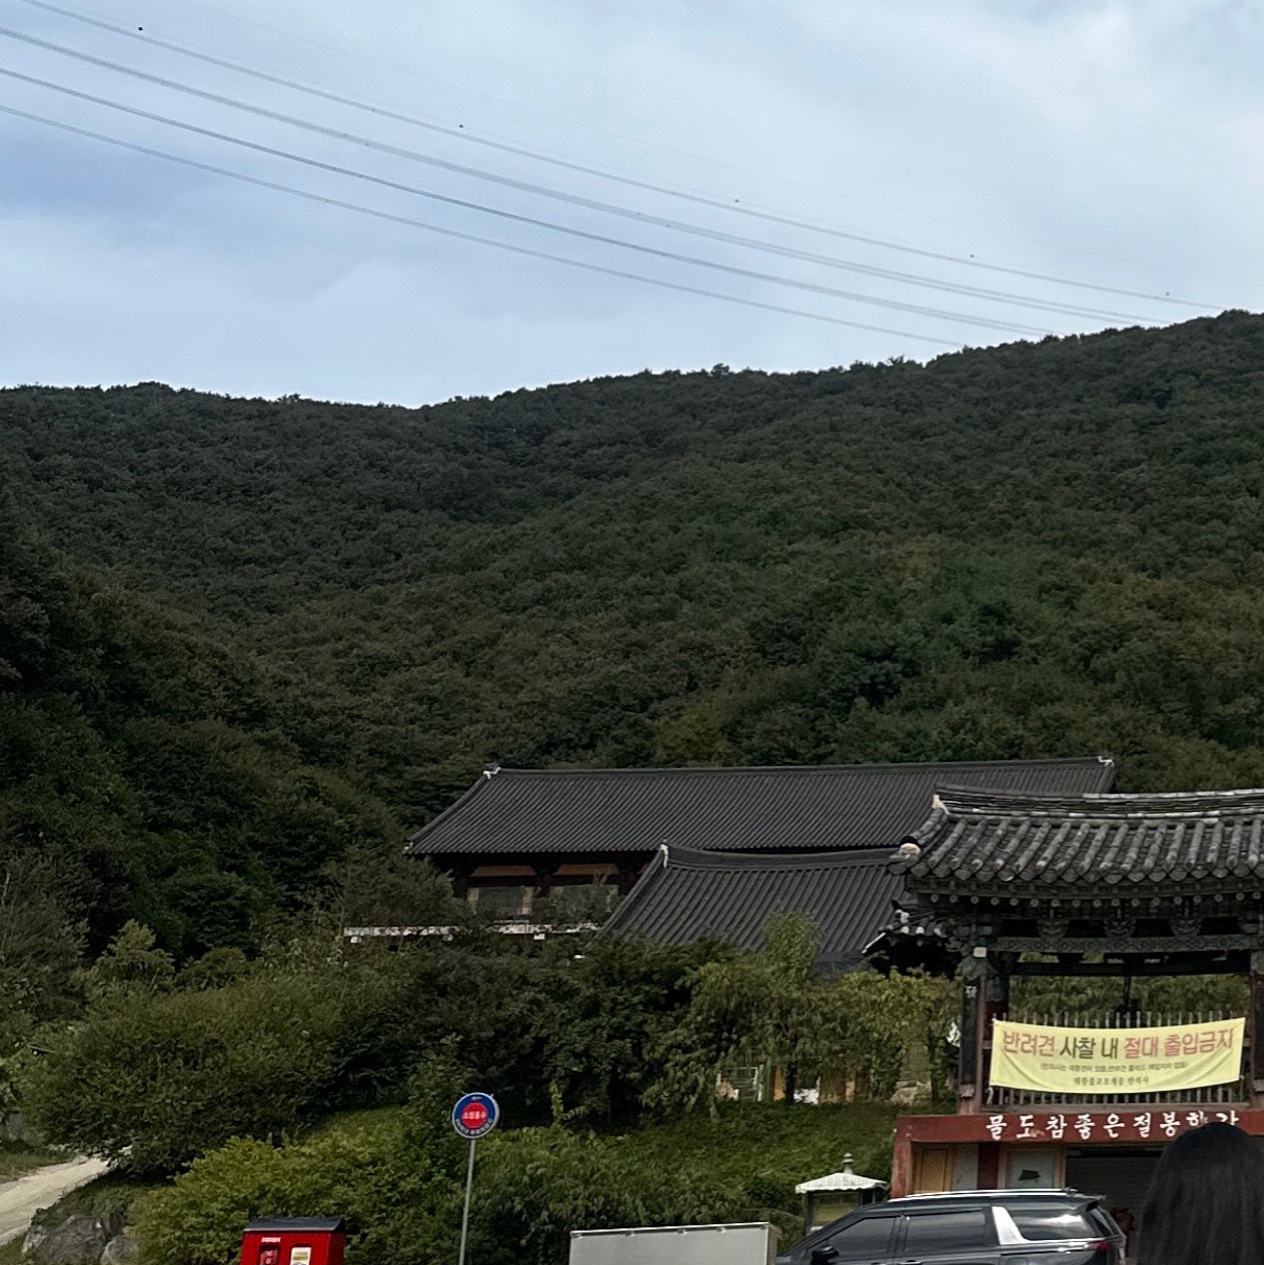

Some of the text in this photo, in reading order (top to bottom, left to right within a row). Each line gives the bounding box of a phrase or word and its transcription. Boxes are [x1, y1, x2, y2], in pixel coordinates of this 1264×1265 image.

[1003, 1028, 1234, 1060] 반려견 사찰 내 절대 출입금지
